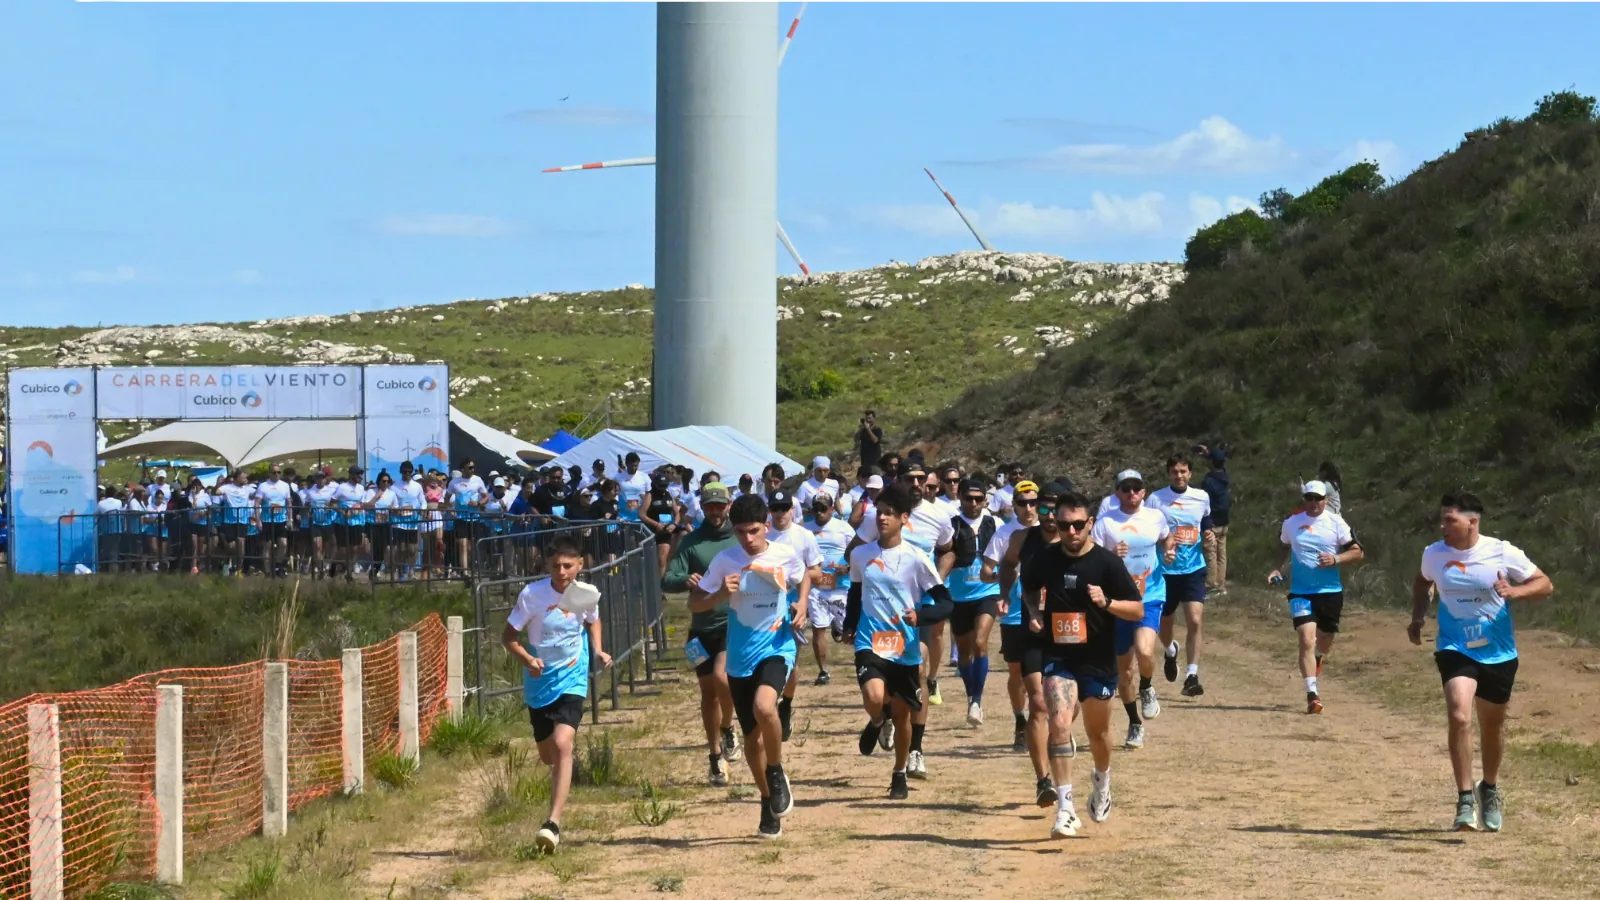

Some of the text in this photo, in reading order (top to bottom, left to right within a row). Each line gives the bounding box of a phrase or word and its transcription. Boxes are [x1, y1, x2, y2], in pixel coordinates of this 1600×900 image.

[21, 384, 60, 394] Cubico
[376, 380, 415, 389] Cubico
[193, 395, 237, 406] Cubico
[1056, 619, 1080, 633] 368
[877, 636, 899, 648] 437
